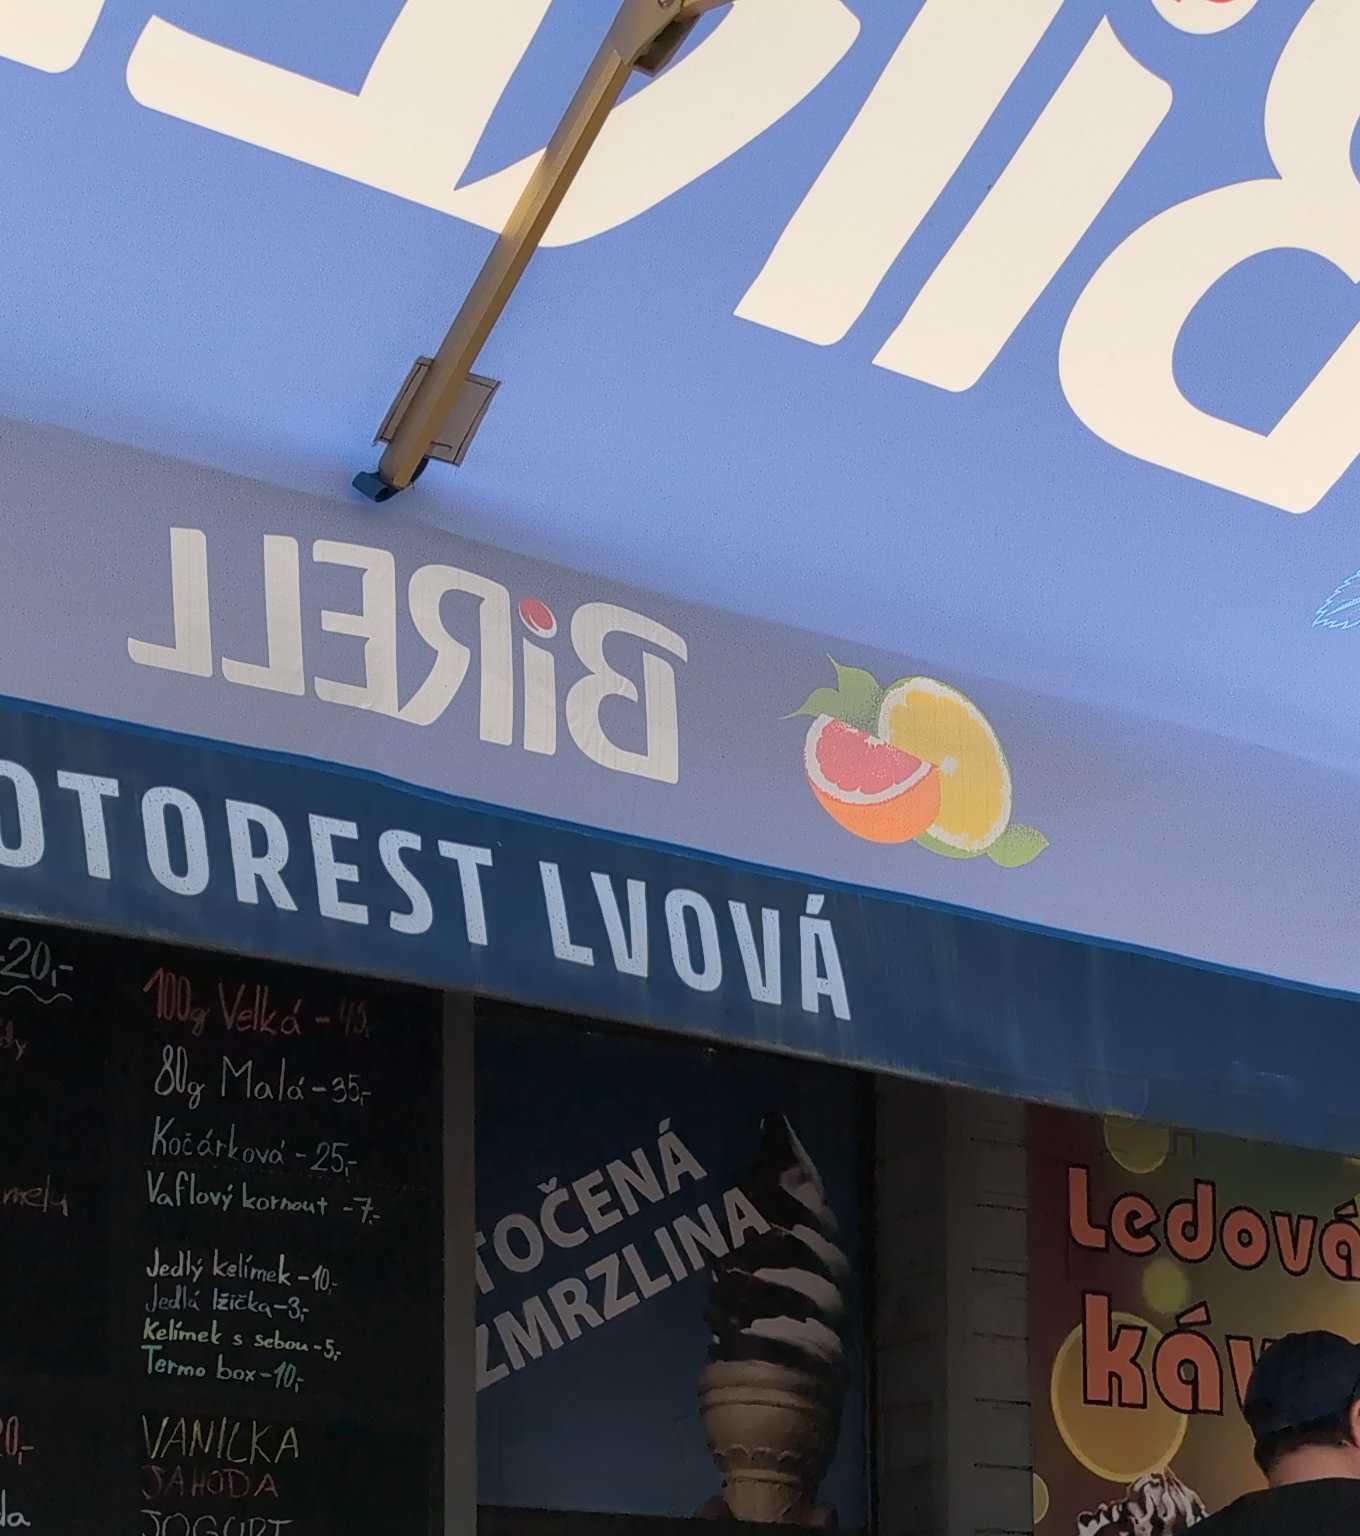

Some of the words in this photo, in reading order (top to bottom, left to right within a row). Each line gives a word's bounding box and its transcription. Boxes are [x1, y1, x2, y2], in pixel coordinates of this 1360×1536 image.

[538, 861, 851, 1020] LVOVÁ
[218, 981, 302, 1036] Velká
[154, 1044, 205, 1110] 80g
[221, 1056, 305, 1101] Malá
[151, 1115, 286, 1165] Kočárková
[147, 1169, 234, 1212] Vaflový
[242, 1181, 328, 1216] kornout
[146, 1247, 203, 1283] Jedlý
[212, 1248, 291, 1286] kelímek
[145, 1282, 201, 1313] Jedlá
[143, 1317, 223, 1346] Kelímek
[232, 1334, 244, 1347] s
[141, 1344, 207, 1378] Termo
[141, 1464, 279, 1500] JAHODA
